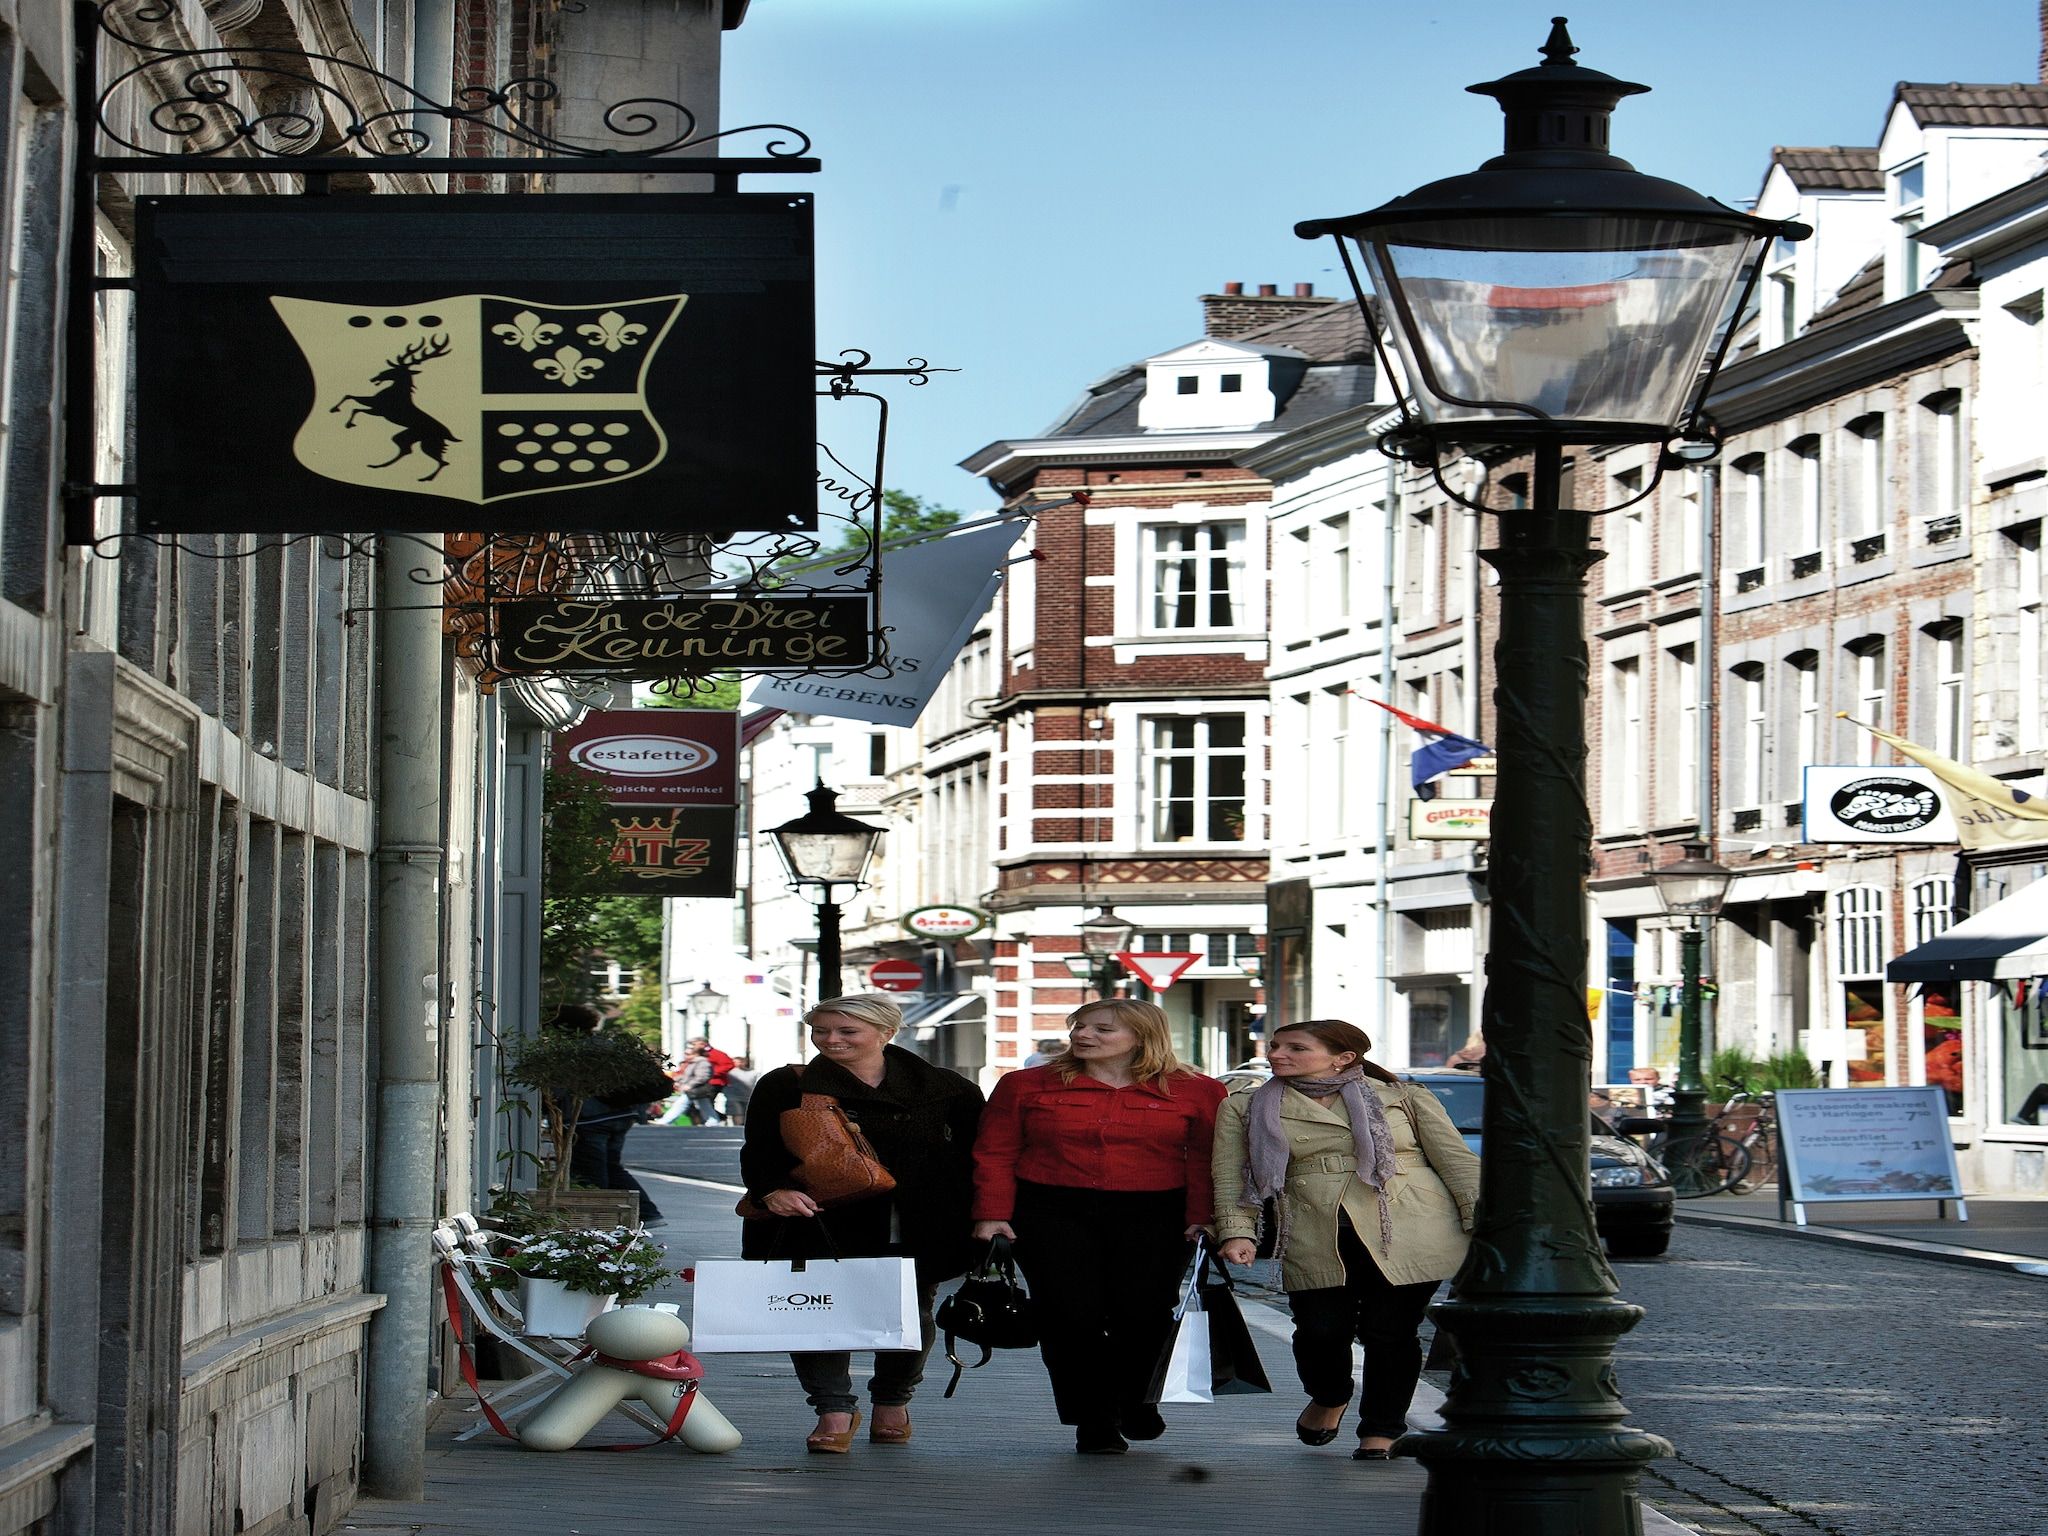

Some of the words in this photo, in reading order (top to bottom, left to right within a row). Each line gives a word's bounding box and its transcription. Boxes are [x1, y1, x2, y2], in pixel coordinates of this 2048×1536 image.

[537, 601, 628, 632] In
[642, 603, 701, 632] de
[699, 601, 833, 632] Drei
[514, 626, 848, 664] Keuninge
[771, 679, 918, 710] RUEBENS
[592, 749, 696, 761] estafette
[661, 786, 723, 794] eetwinkel
[1853, 816, 1926, 833] MAASTRICHT
[1793, 1102, 1868, 1111] Gestoomde
[1873, 1101, 1928, 1109] makreel
[1822, 1110, 1884, 1120] Haringen
